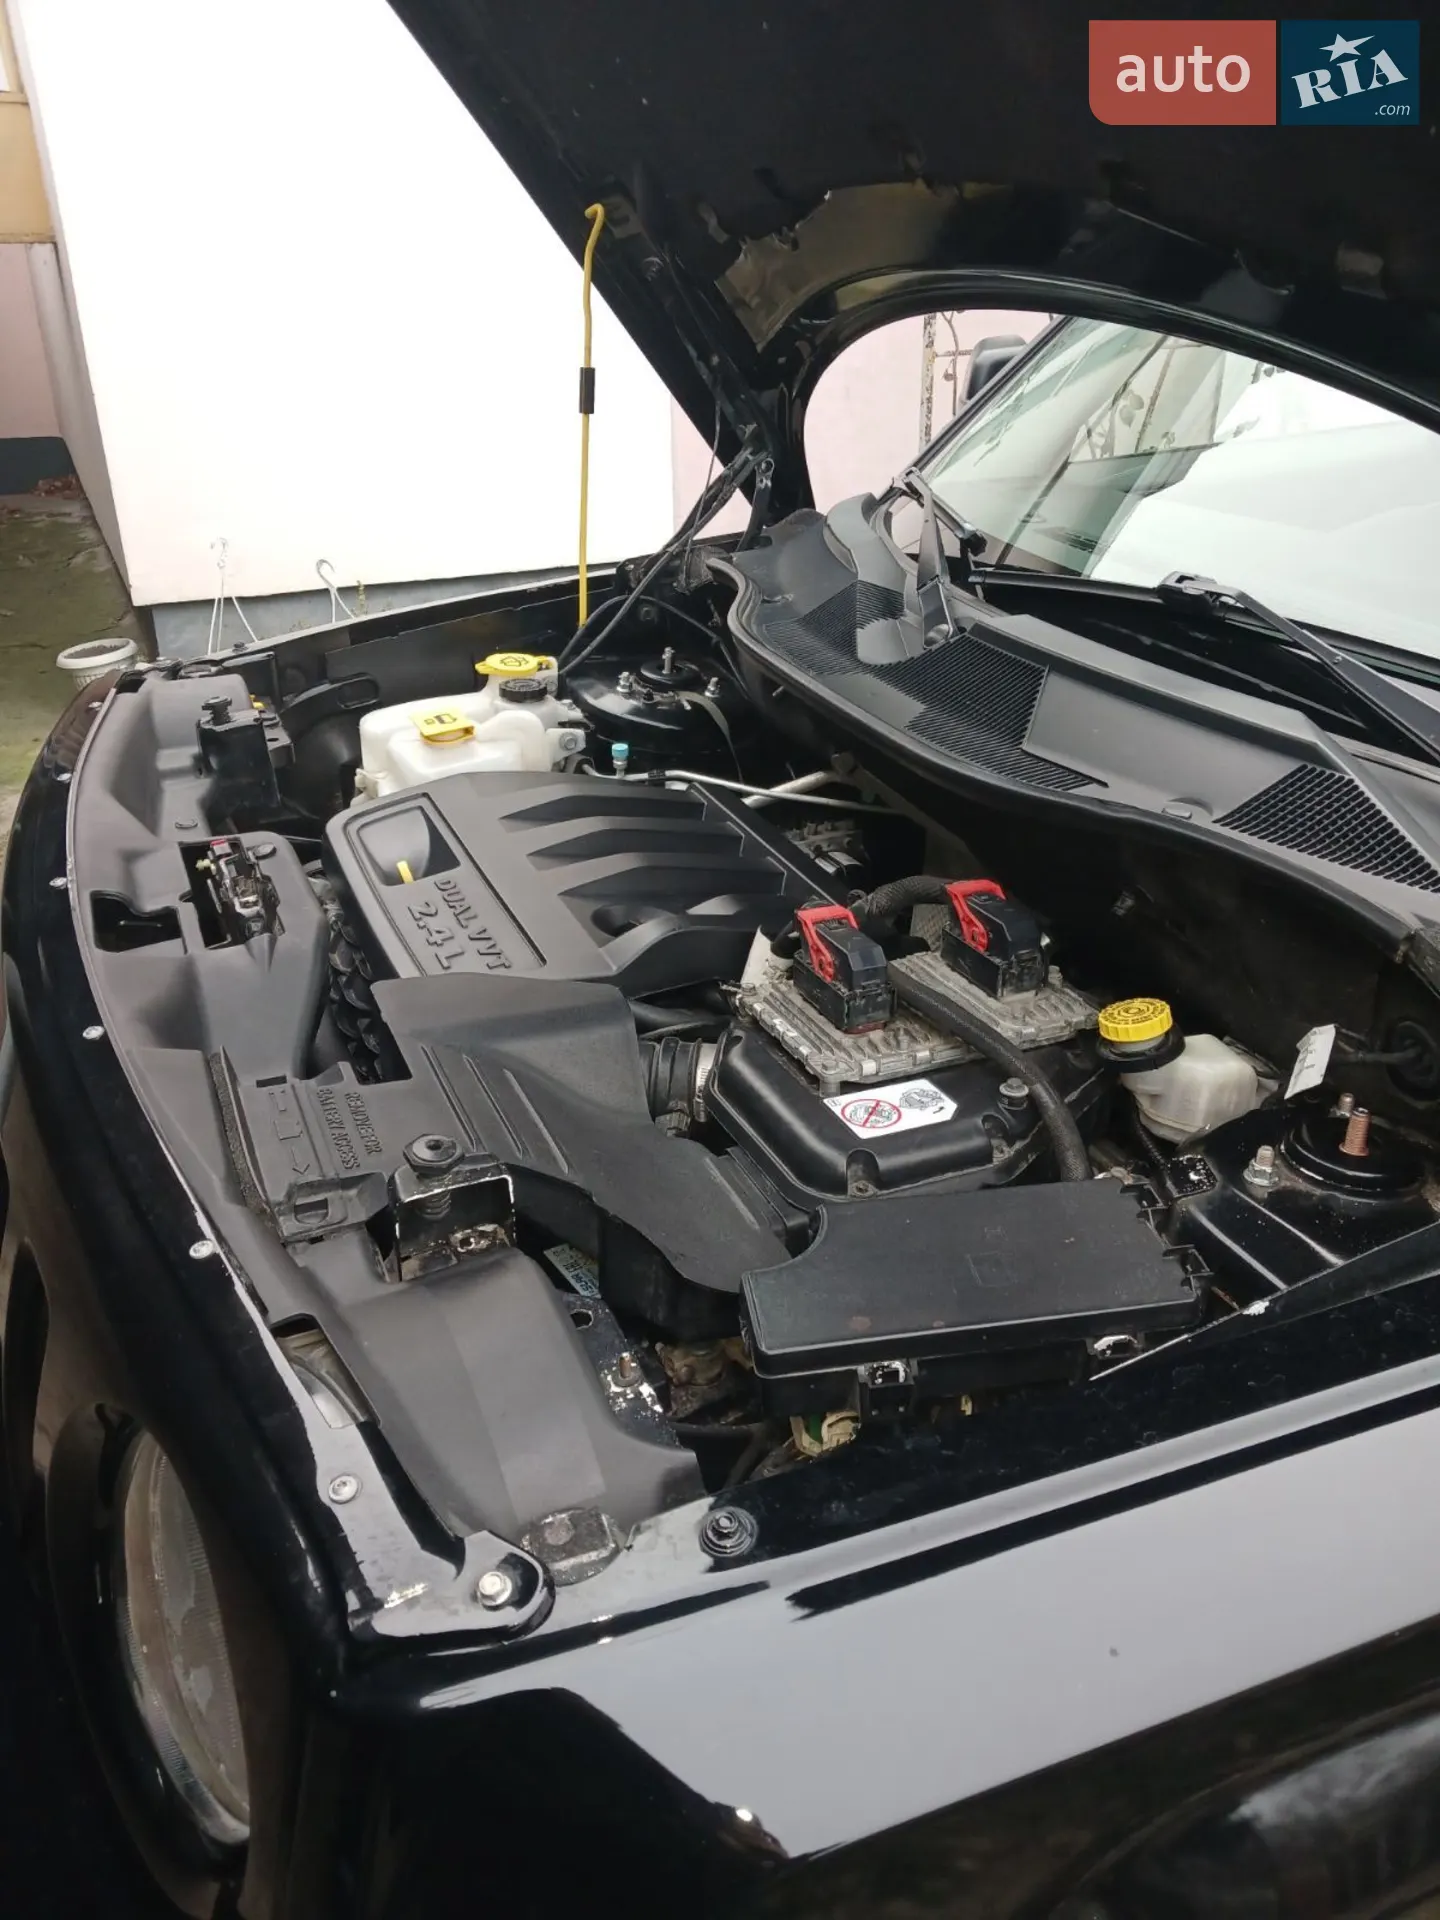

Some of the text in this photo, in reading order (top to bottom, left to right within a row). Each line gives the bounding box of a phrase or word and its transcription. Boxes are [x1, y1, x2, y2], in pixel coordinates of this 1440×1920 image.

[433, 879, 513, 970] DUAL VVT
[316, 1088, 361, 1170] BATTERY ACCESS
[344, 1091, 383, 1155] REMOVE FOR
